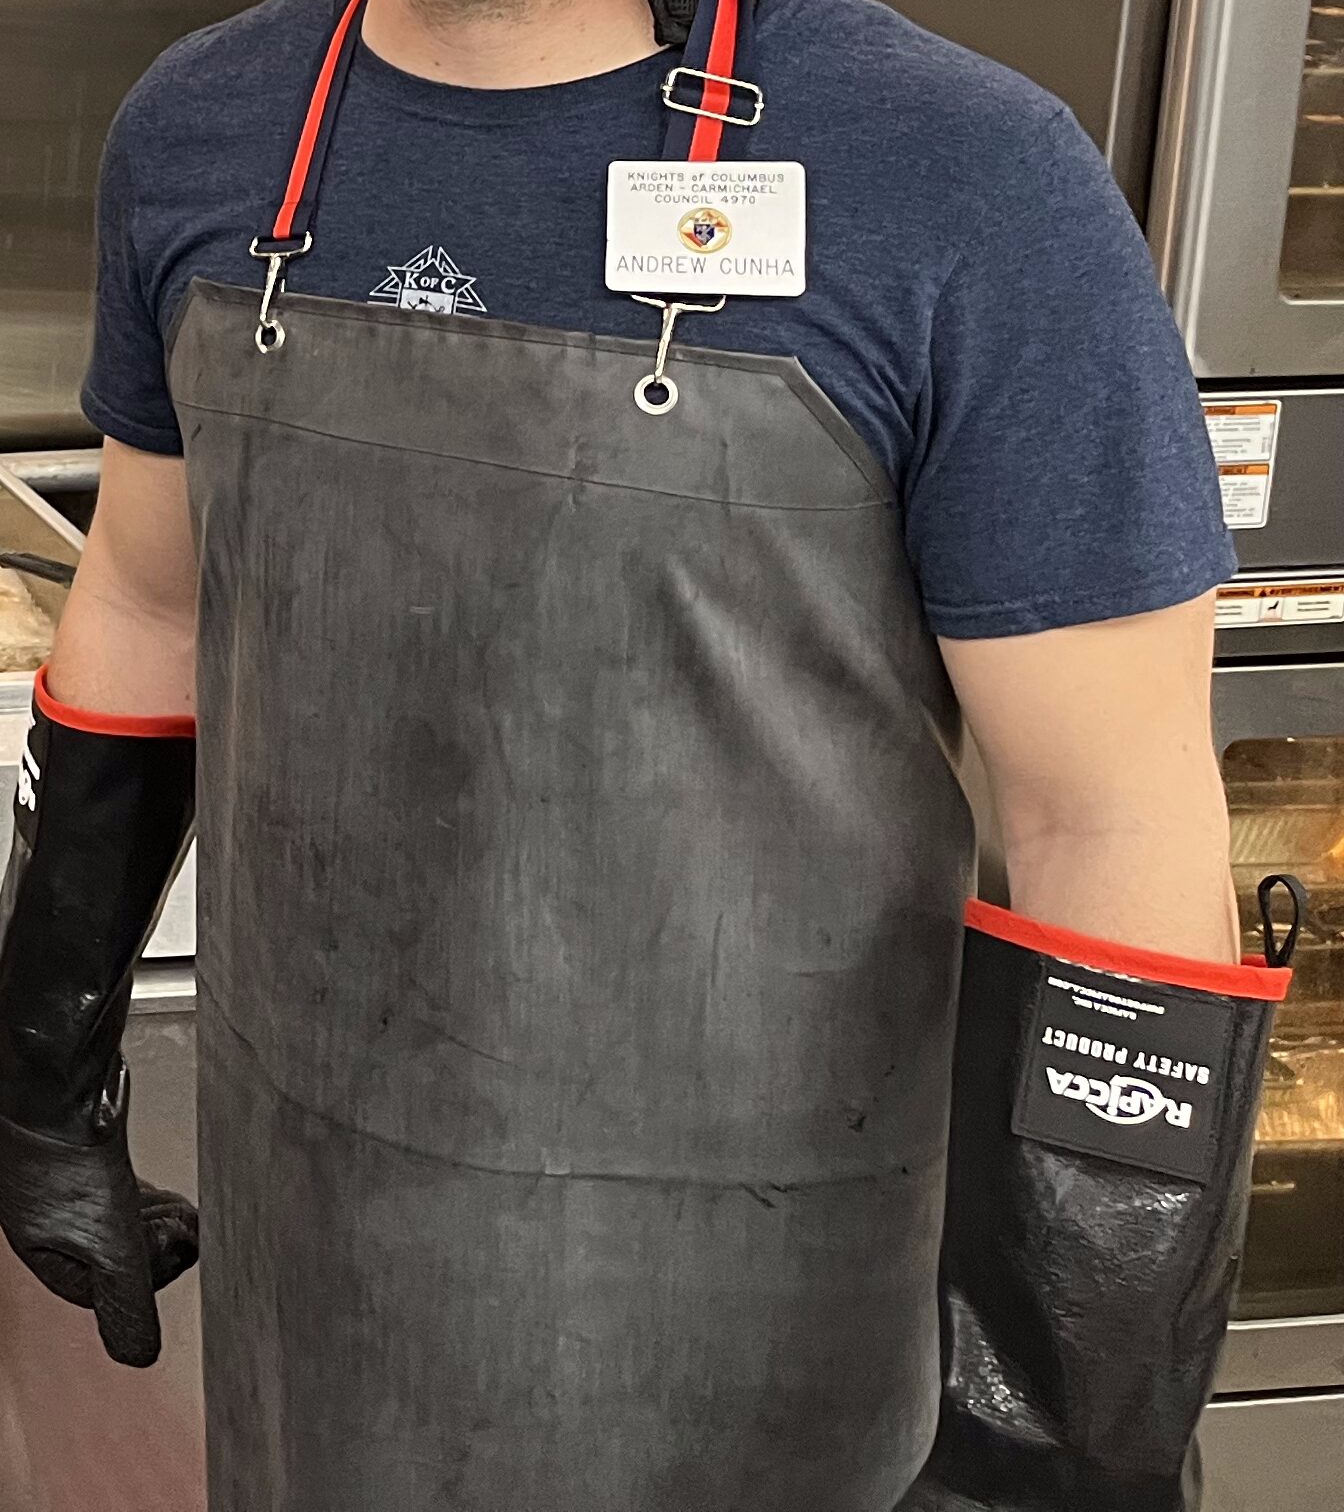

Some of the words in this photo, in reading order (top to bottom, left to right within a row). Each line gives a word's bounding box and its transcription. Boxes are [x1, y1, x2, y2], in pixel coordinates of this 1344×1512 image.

[627, 172, 685, 182] KNIGHTS
[711, 173, 785, 183] COLUMBUS
[630, 183, 674, 192] ARDEN
[691, 183, 778, 194] CARMICHAEL
[654, 194, 713, 204] COUNCIL
[720, 195, 756, 205] 4970
[616, 256, 707, 274] ANDREW
[719, 257, 795, 276] CUNHA
[404, 272, 420, 289] K
[420, 276, 439, 288] OF
[440, 277, 457, 293] C
[1041, 1026, 1129, 1065] PRODUCT
[1133, 1051, 1211, 1086] SAFETY
